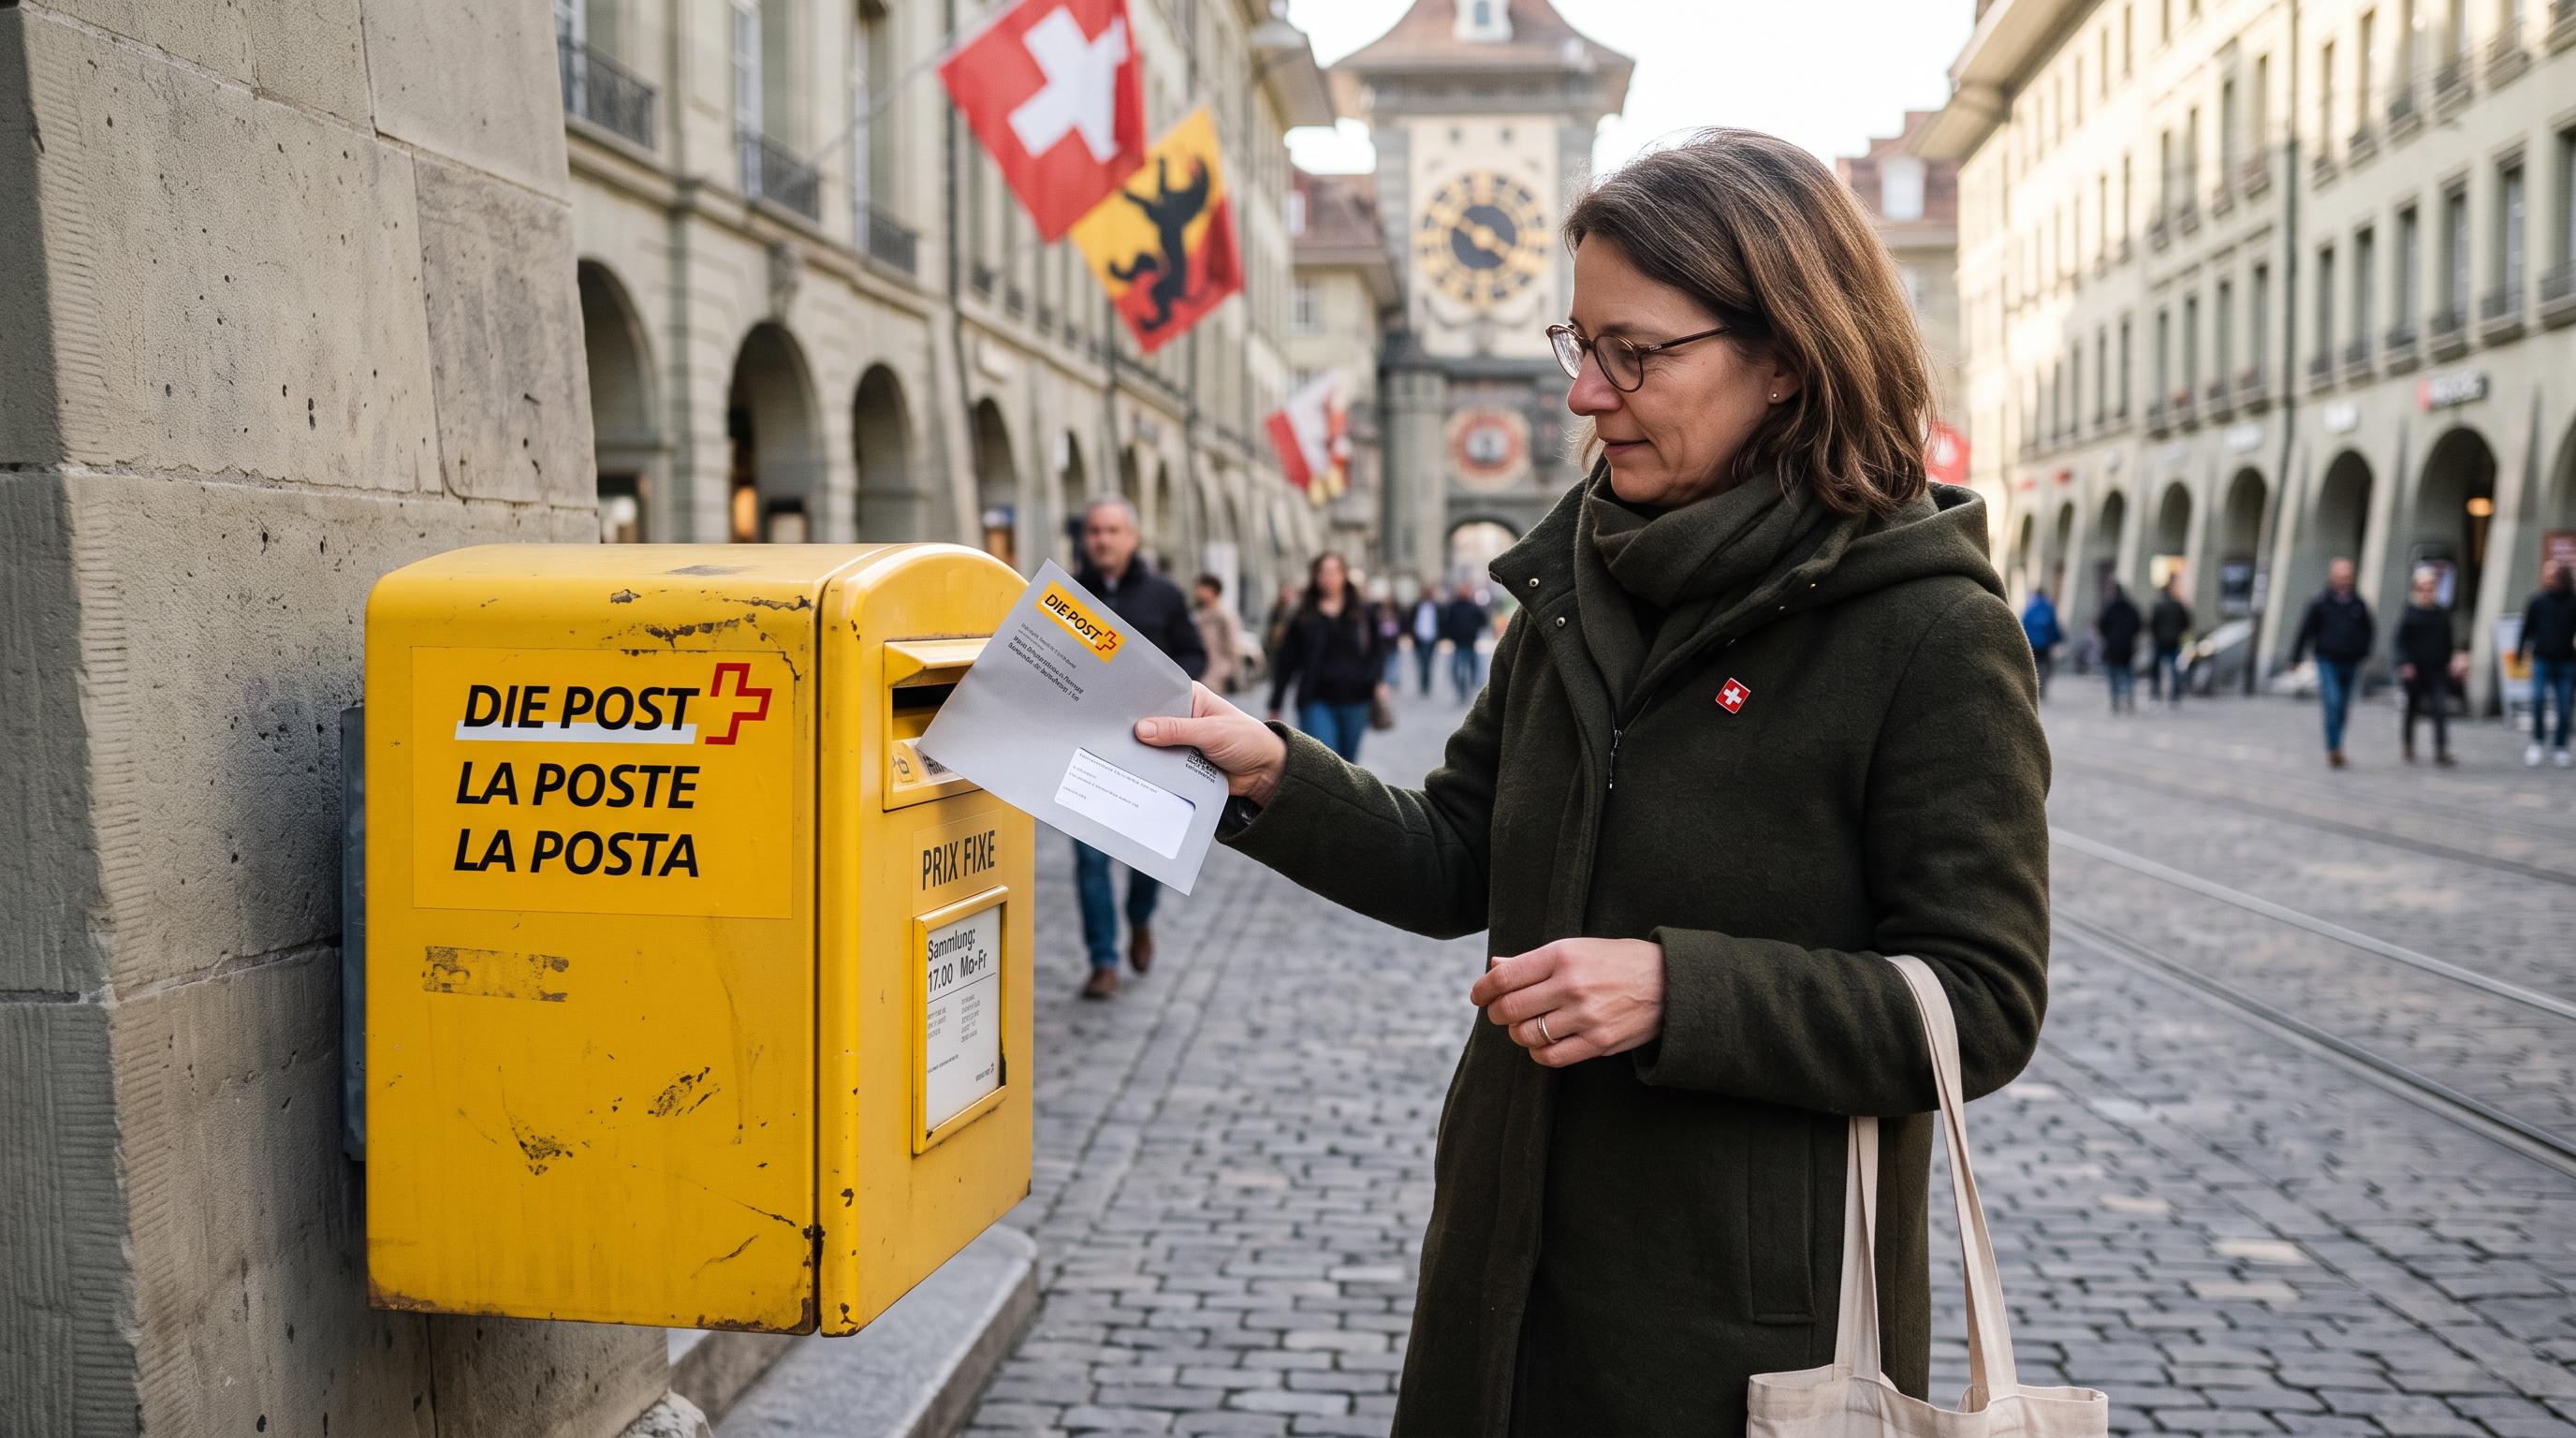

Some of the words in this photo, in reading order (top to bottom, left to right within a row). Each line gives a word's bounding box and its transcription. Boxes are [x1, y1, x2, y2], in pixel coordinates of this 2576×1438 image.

[1044, 594, 1070, 617] DIE
[1065, 610, 1103, 640] POST
[463, 684, 550, 728] DIE
[560, 685, 701, 731] POST
[456, 761, 519, 805] LA
[532, 763, 701, 809] POSTE
[454, 828, 517, 873] LA
[530, 830, 699, 877] POSTA
[922, 841, 959, 890] PRIX
[963, 830, 996, 877] FIXE
[928, 928, 975, 962] Sammlung:
[928, 962, 953, 992] 17.00
[960, 948, 988, 978] Mo-Fr
